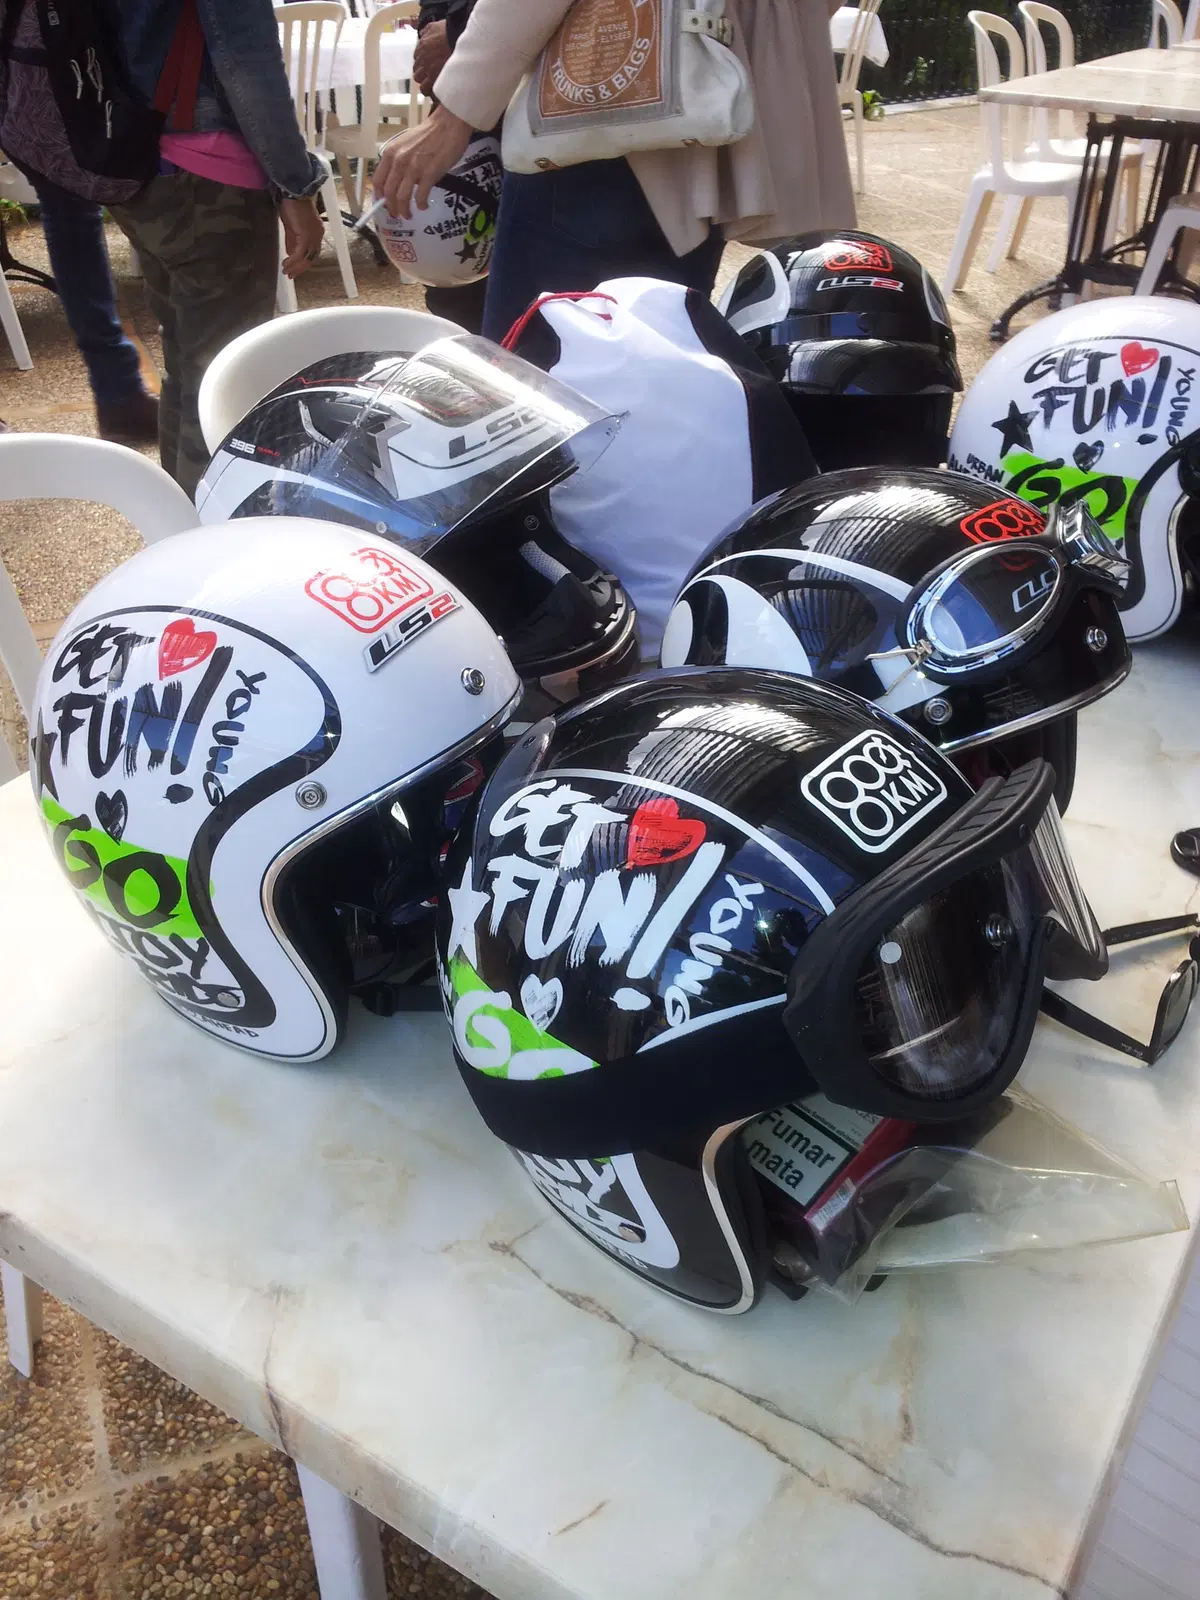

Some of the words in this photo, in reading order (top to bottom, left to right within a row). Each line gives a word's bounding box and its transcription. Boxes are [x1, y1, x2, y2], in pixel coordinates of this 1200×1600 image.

[551, 57, 596, 104] TRUNKS
[598, 84, 612, 100] &
[611, 37, 651, 90] BAGS
[423, 213, 470, 236] AHEAD
[816, 275, 904, 293] LS2
[1024, 347, 1118, 385] GET
[1032, 355, 1172, 446] FUN!
[1165, 367, 1196, 446] YOUNG
[229, 437, 257, 455] 396
[966, 453, 1005, 483] URBAN
[1003, 457, 1128, 527] GO
[372, 574, 421, 605] KM
[52, 623, 156, 695] GET
[364, 592, 459, 672] LS2
[52, 645, 234, 804] FUN!
[203, 669, 267, 807] YOUNG
[490, 779, 629, 871] GET
[880, 769, 935, 815] KM
[53, 813, 182, 929] GO
[487, 841, 727, 1011] FUN!
[664, 873, 765, 1028] YOUNG
[747, 1139, 804, 1190] mata
[758, 1108, 836, 1169] Fumar
